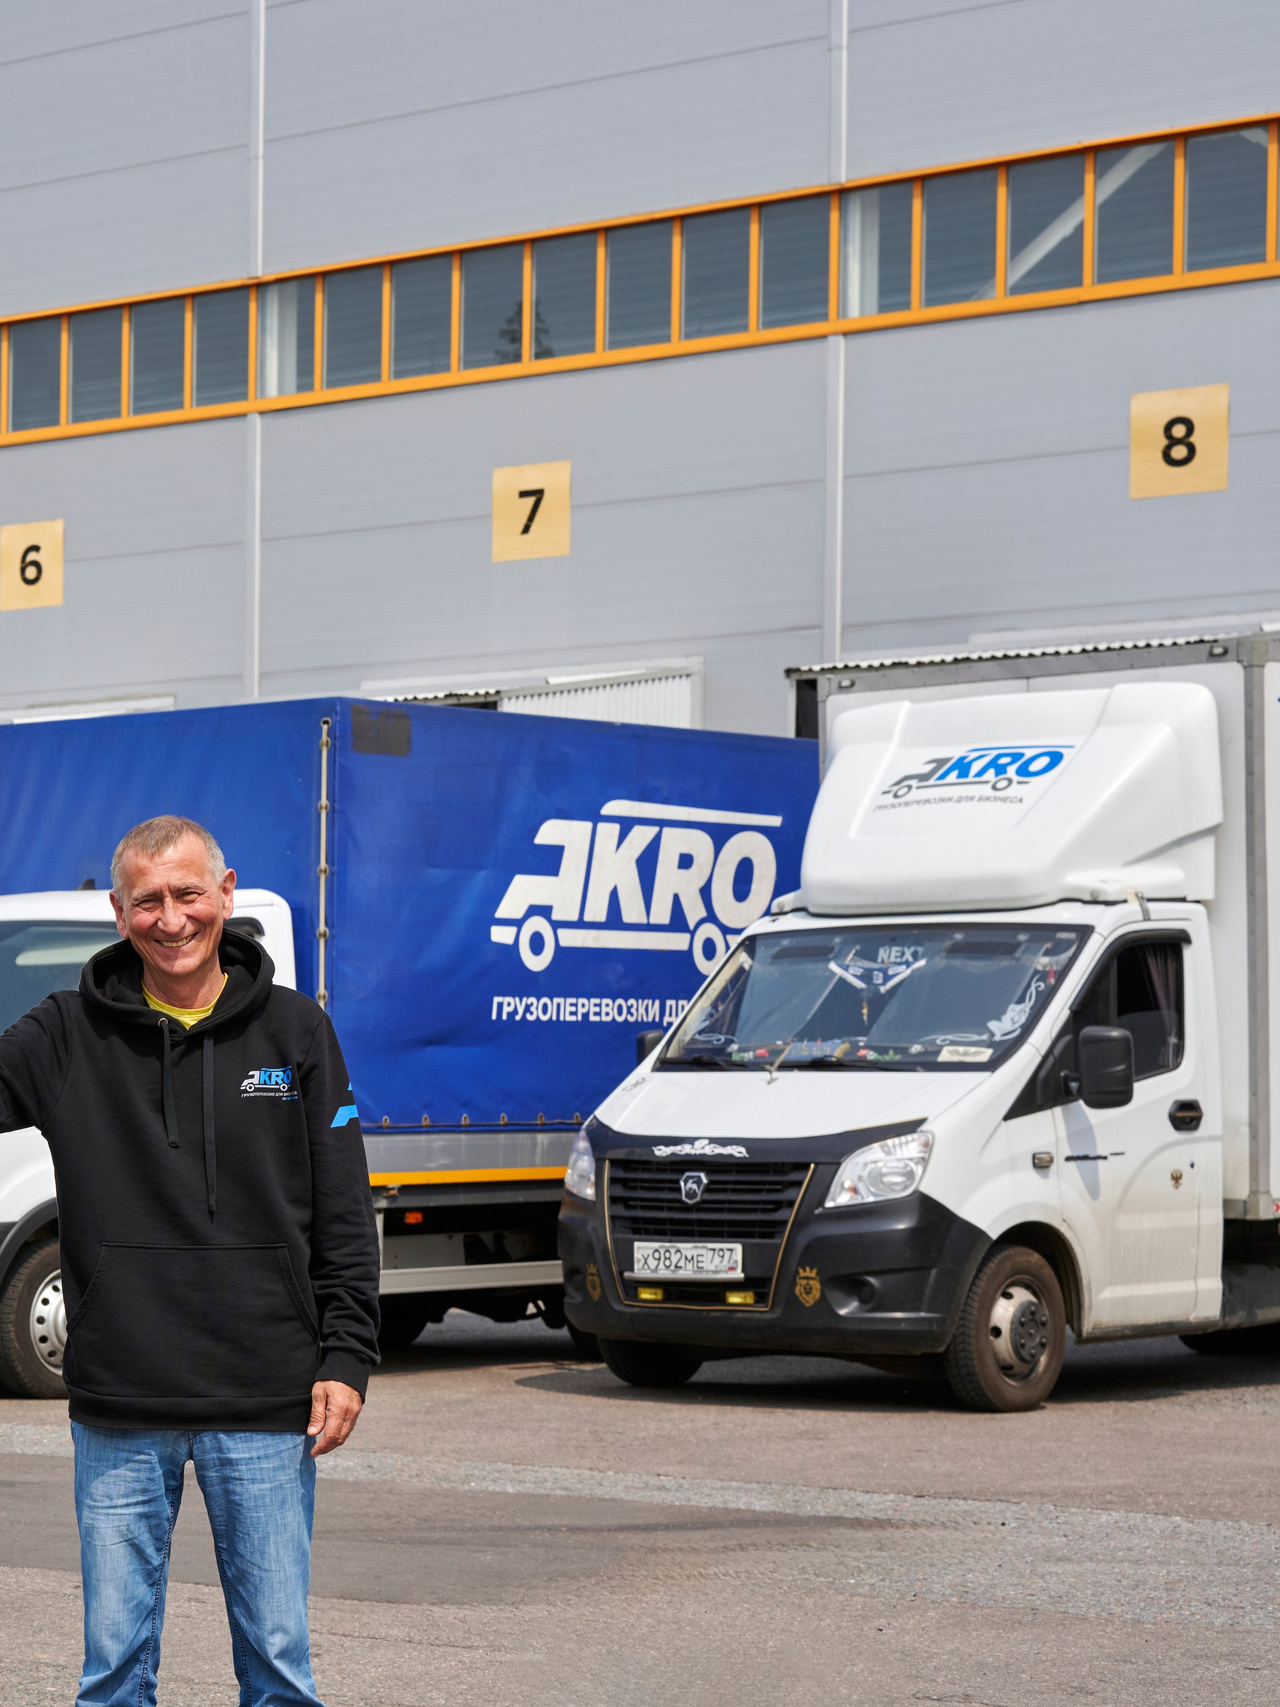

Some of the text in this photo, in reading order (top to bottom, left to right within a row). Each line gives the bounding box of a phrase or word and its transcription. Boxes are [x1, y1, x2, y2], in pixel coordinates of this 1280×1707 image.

[1161, 416, 1197, 468] 8
[518, 488, 545, 535] 7
[19, 544, 43, 586] 6
[889, 750, 1064, 788] AKRO
[494, 818, 777, 930] AKRO
[491, 996, 660, 1023] ГРУЗОПЕРЕВОЗКИ
[241, 1069, 293, 1087] AKRO
[708, 1248, 734, 1264] 797
